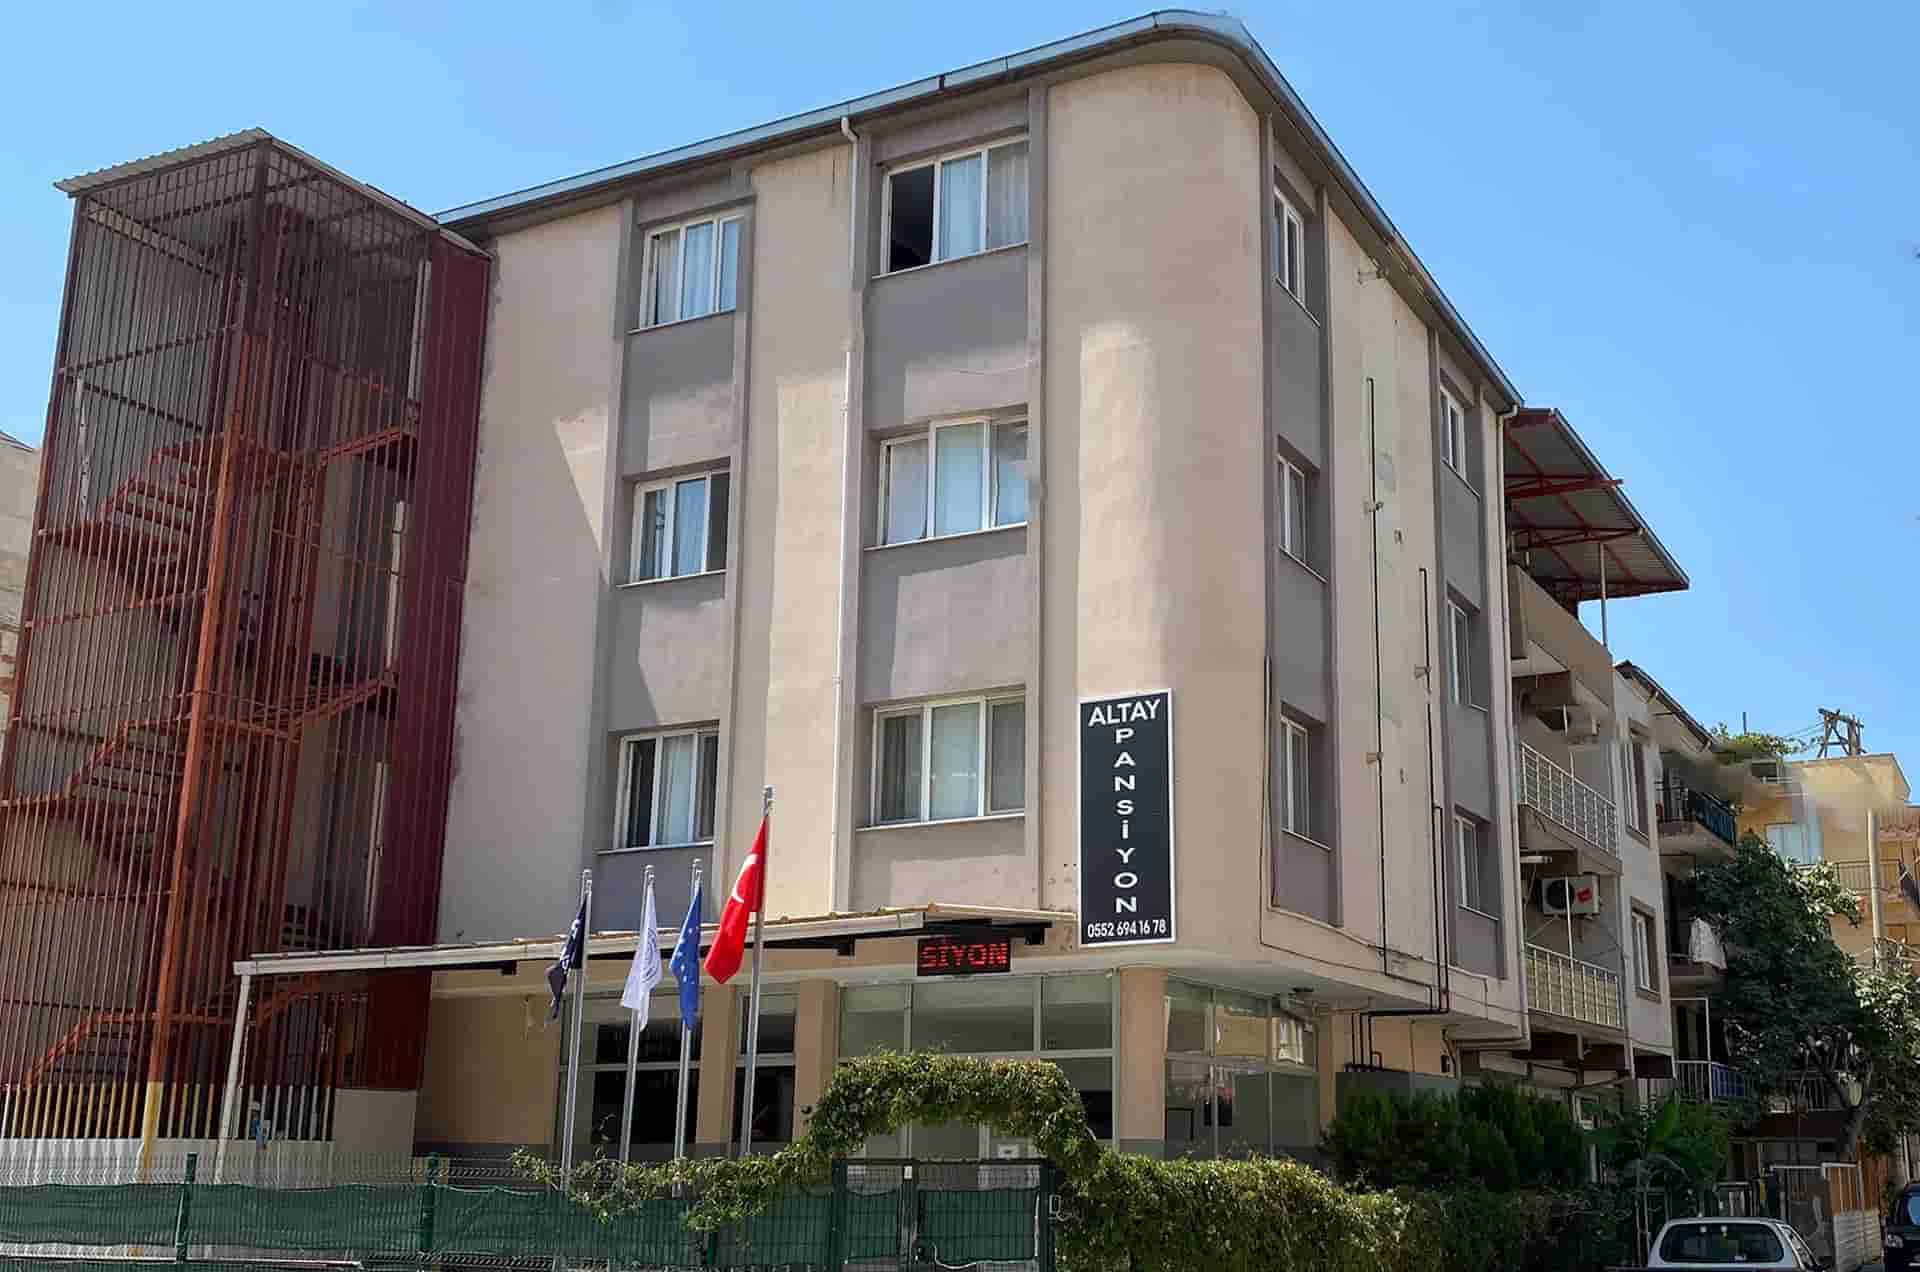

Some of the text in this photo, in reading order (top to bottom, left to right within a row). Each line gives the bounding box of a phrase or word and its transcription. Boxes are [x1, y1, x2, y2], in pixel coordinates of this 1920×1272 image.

[1088, 699, 1160, 727] ALTAY
[1087, 919, 1166, 938] 0552 694 16 78
